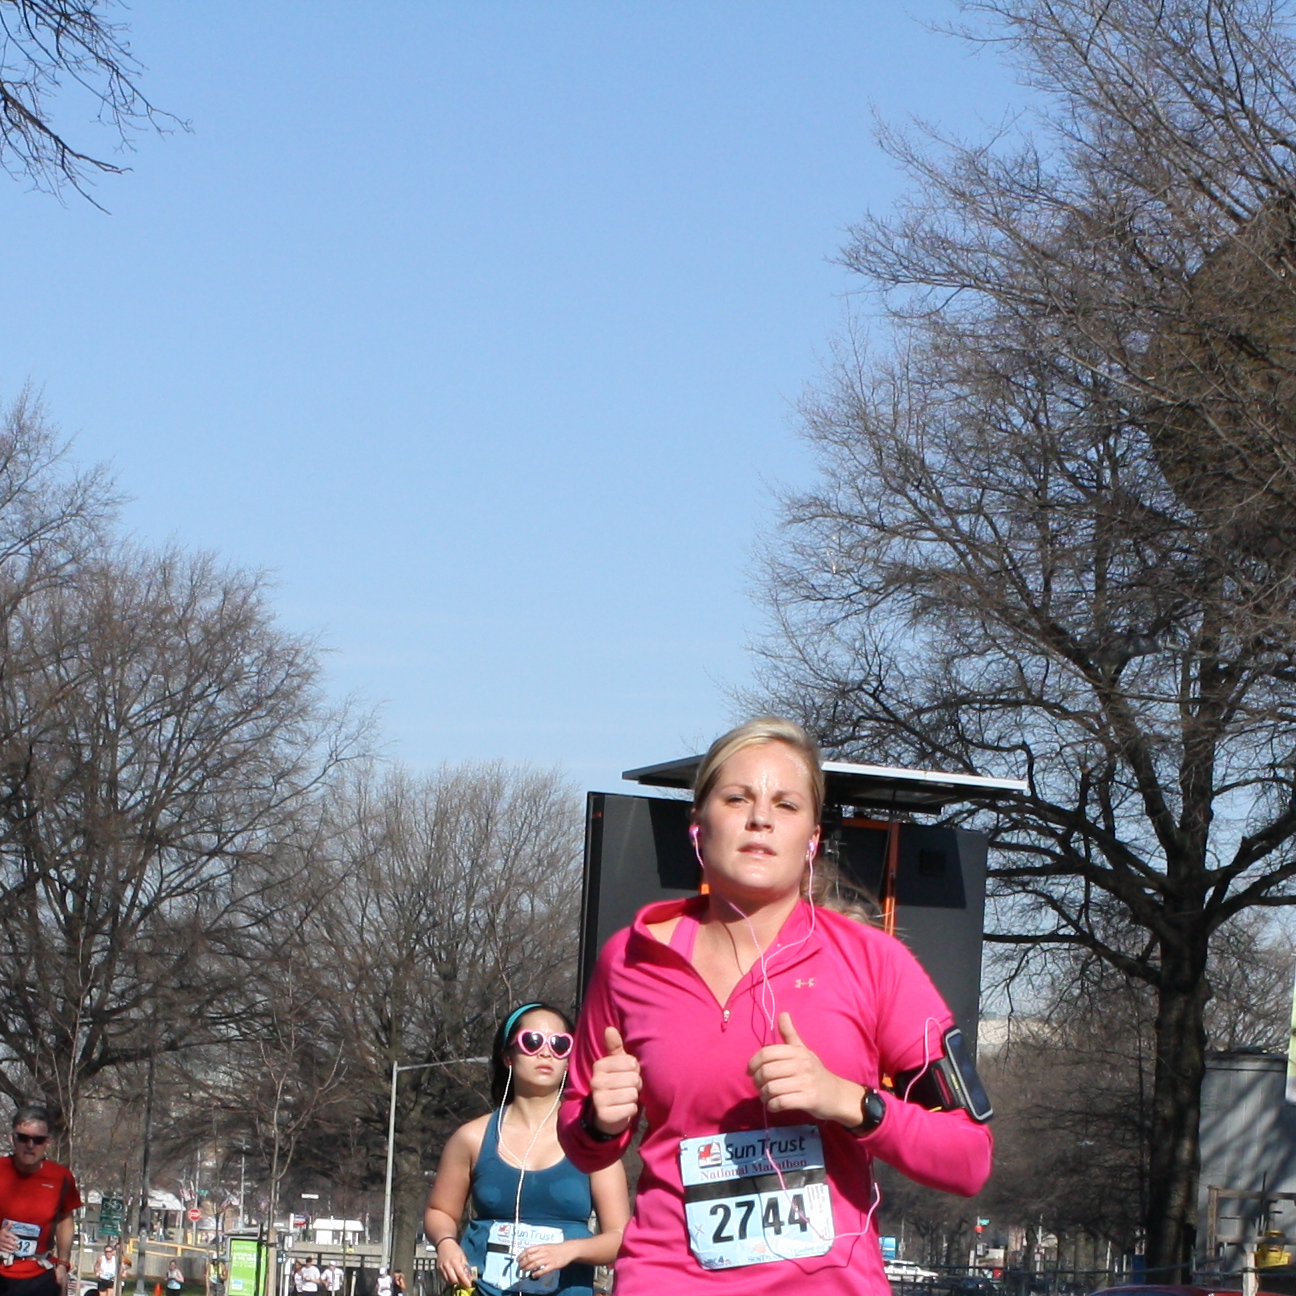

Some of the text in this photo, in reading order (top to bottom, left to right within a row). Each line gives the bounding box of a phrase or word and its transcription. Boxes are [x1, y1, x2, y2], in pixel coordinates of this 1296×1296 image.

[725, 1135, 807, 1161] SunTrust
[700, 1164, 749, 1182] National
[709, 1194, 810, 1244] 2744
[512, 1228, 555, 1241] unTrust
